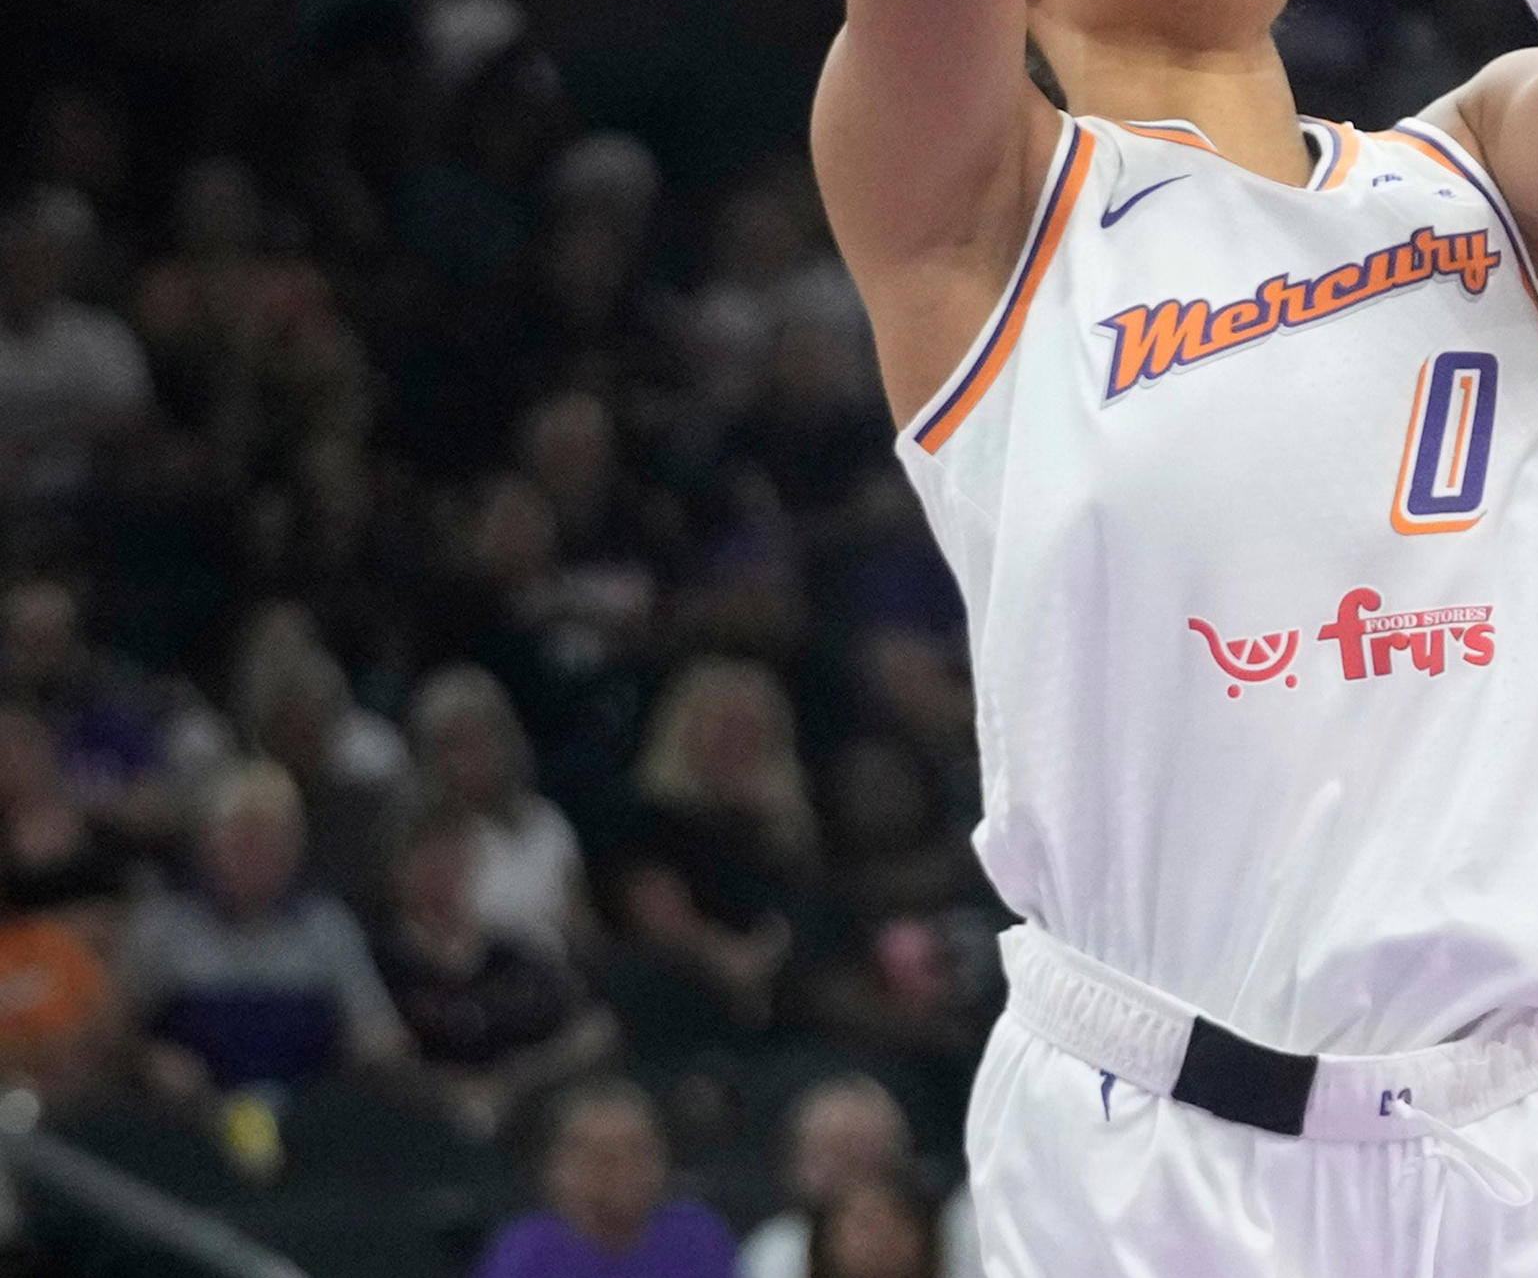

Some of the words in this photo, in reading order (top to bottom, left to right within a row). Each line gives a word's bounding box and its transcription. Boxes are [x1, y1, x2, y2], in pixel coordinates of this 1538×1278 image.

[1094, 225, 1501, 407] Mercury
[1391, 351, 1499, 536] 0
[1317, 587, 1496, 681] fry's
[1365, 613, 1418, 633] FOOD
[1421, 606, 1488, 627] STORES
